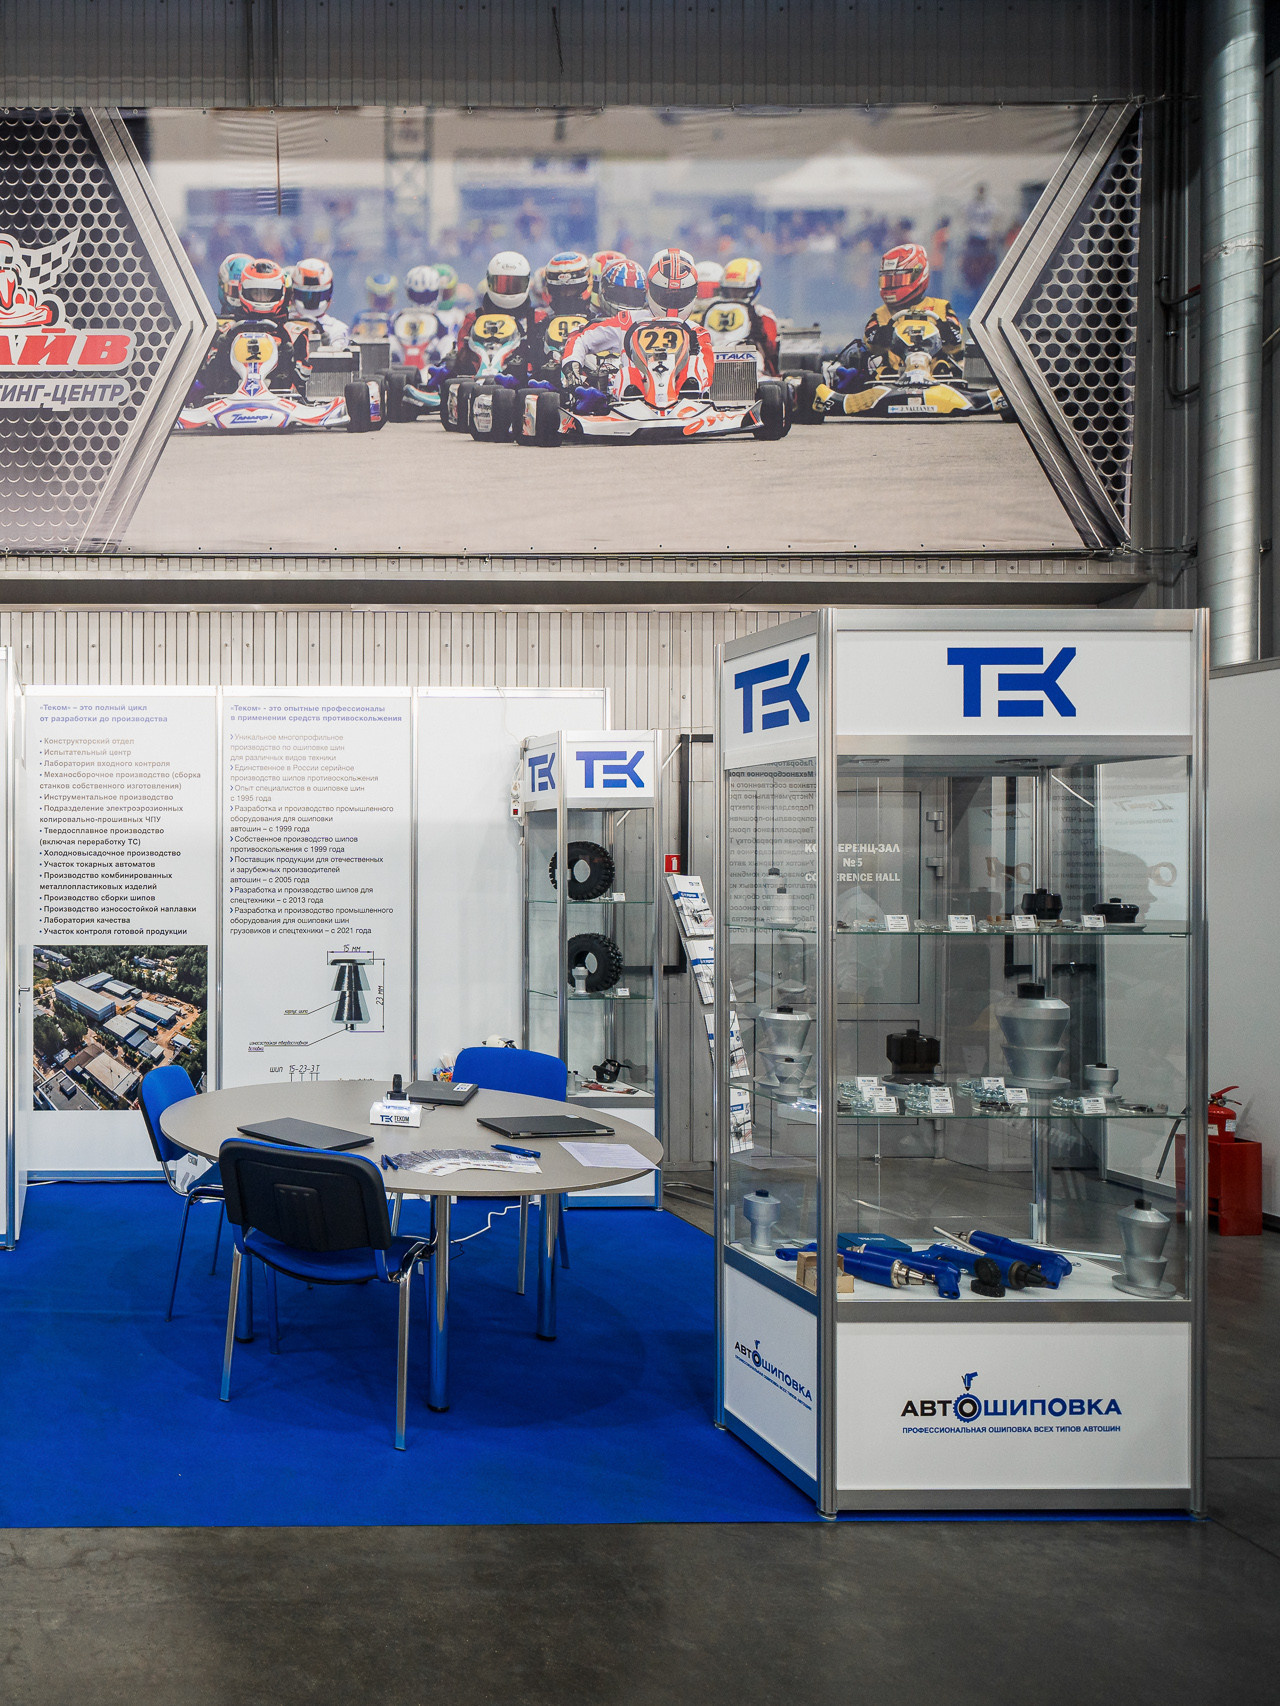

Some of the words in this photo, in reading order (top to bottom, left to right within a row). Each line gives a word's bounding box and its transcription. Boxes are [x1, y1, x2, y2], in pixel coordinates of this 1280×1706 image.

[644, 331, 678, 350] 23
[50, 715, 97, 723] разработки
[804, 844, 900, 854] КОЕРЕНЦ-ЗАЛ
[842, 858, 862, 867] №5
[805, 872, 873, 882] COERENCE
[876, 873, 900, 882] HALL
[734, 1342, 812, 1401] АВТОШИПОВКА
[901, 1393, 1122, 1424] АВТОШИПОВКА
